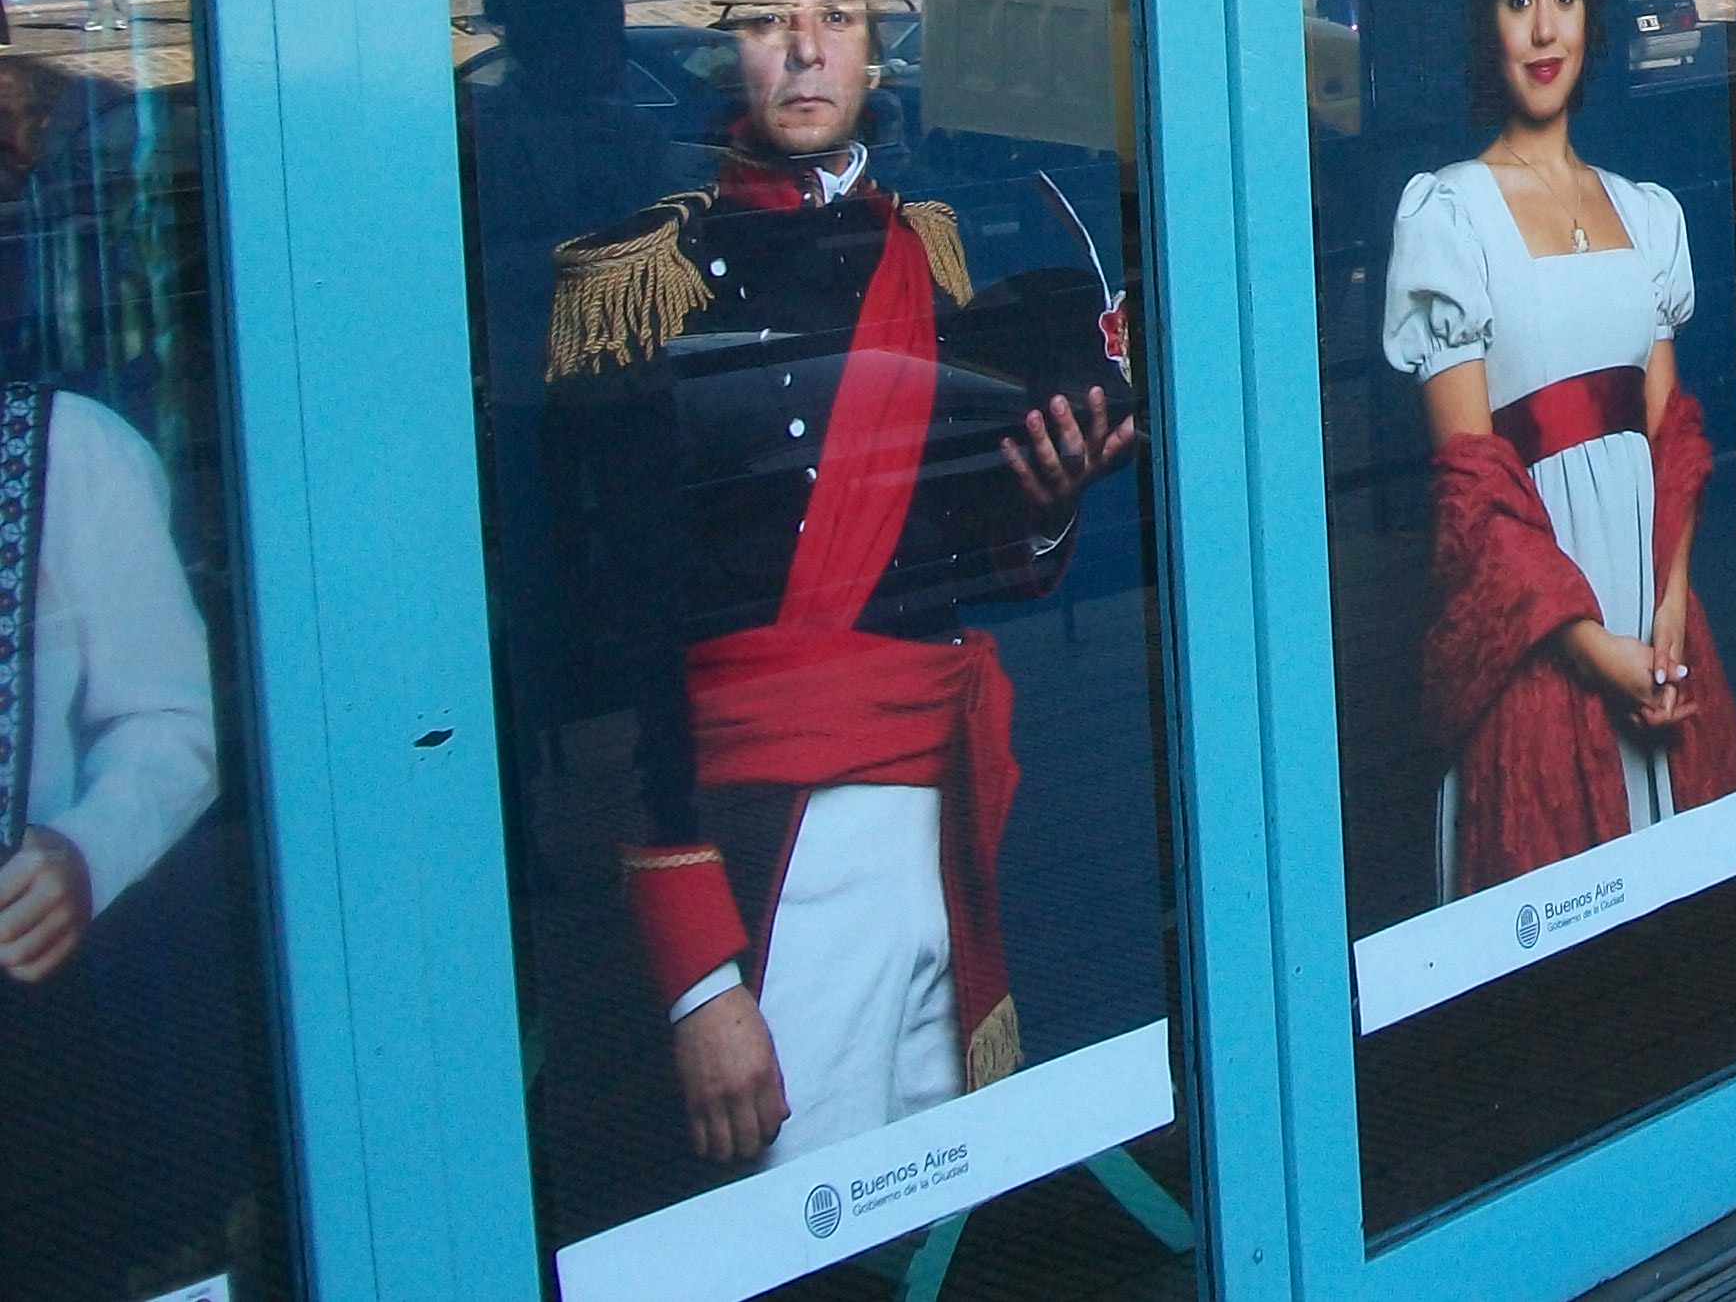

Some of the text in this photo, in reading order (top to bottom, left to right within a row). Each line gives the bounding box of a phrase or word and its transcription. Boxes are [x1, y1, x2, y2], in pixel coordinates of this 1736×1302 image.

[1545, 877, 1623, 920] Buenos Aires
[851, 1143, 968, 1201] Buenos Aires
